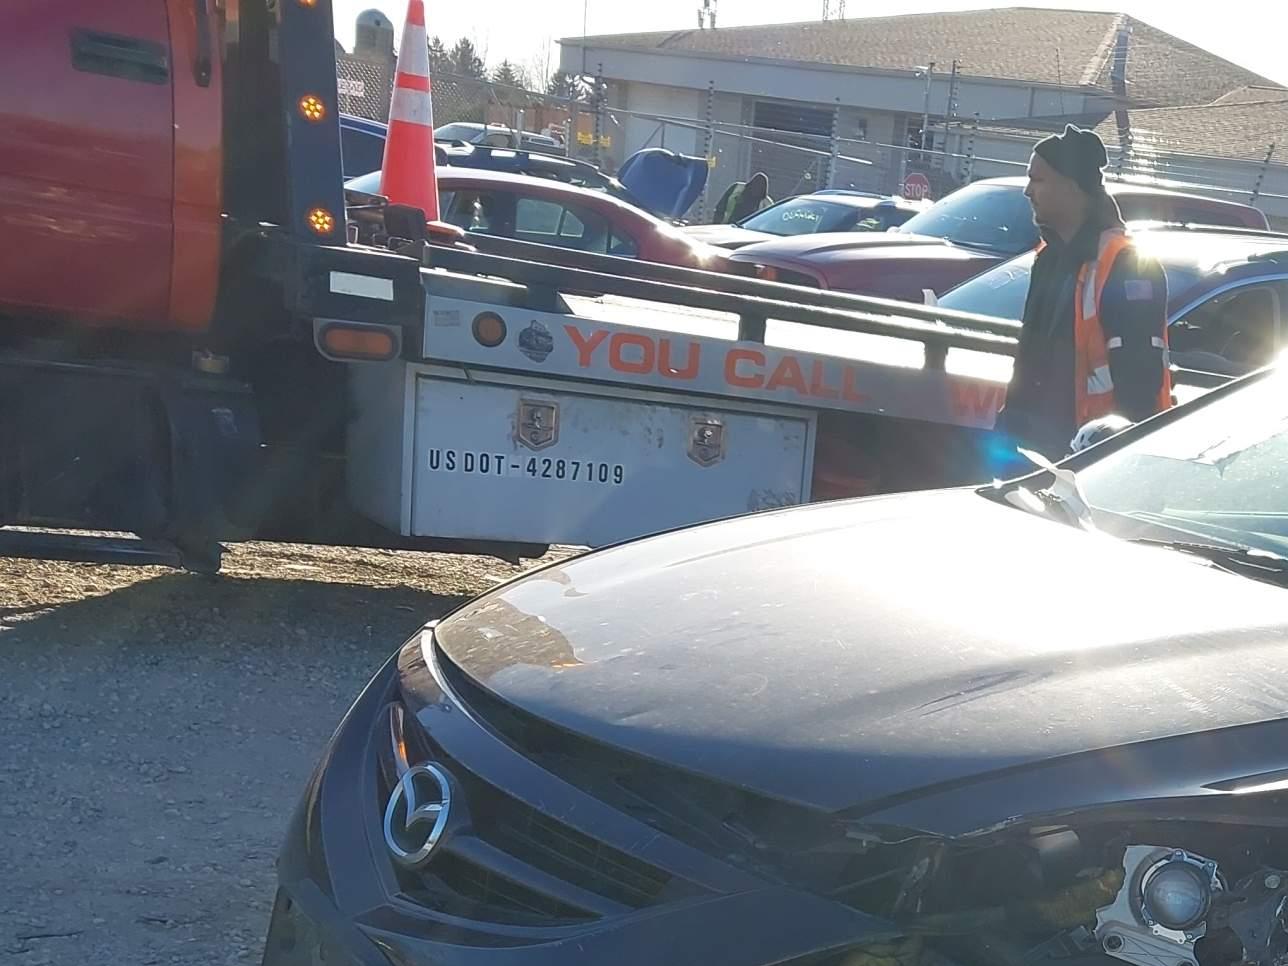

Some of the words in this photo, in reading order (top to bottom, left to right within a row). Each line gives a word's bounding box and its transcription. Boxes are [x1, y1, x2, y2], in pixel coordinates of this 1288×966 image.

[904, 183, 929, 198] STOP
[563, 325, 700, 380] YOU
[724, 347, 871, 405] CALL
